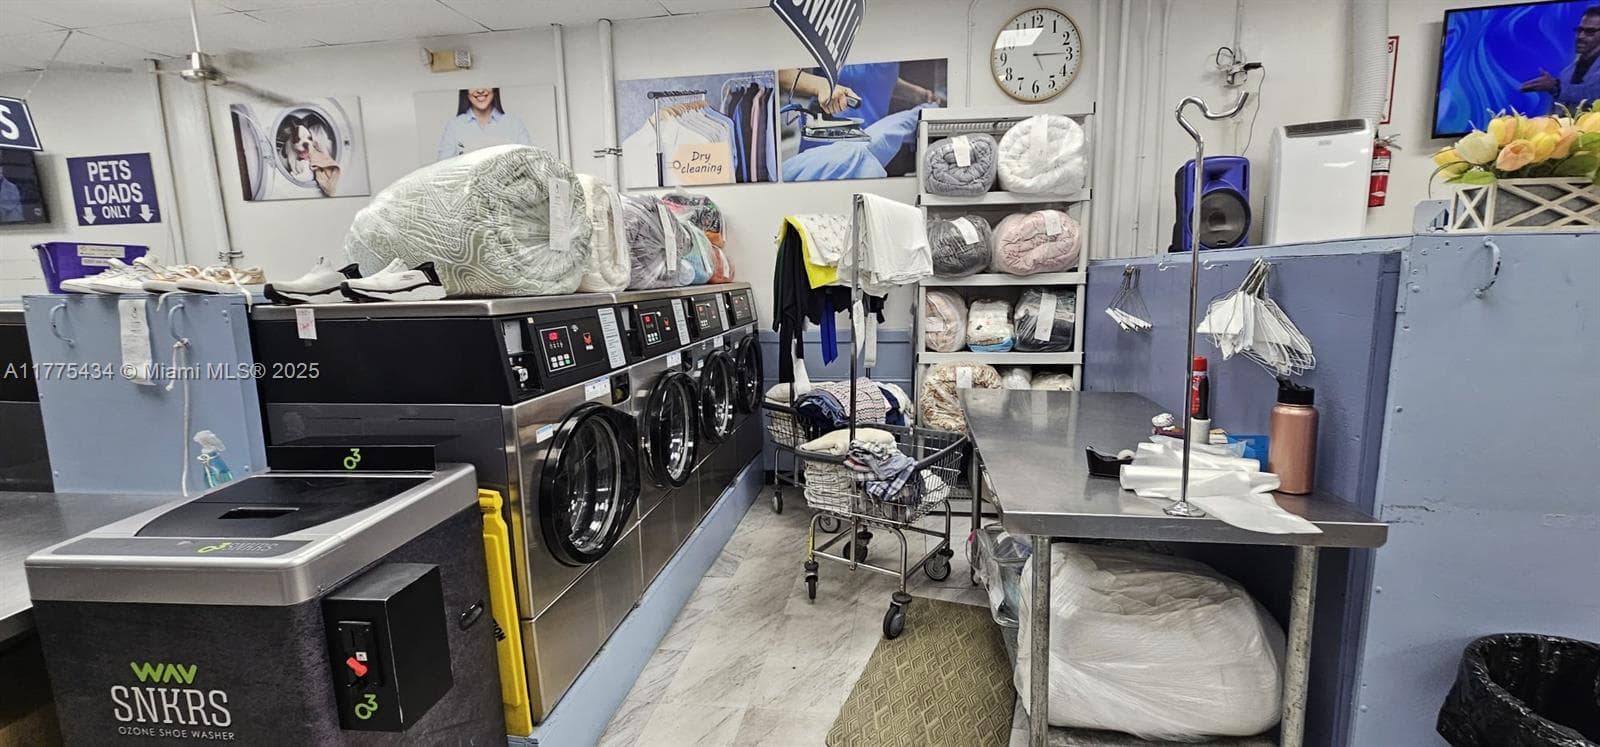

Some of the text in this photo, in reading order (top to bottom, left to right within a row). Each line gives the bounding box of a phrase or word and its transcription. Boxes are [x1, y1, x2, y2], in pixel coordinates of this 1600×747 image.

[1031, 14, 1044, 28] 12
[1062, 31, 1070, 46] 2
[1000, 52, 1008, 66] 9
[1065, 46, 1073, 61] 3
[1005, 67, 1013, 81] 8
[1059, 63, 1067, 77] 4
[1017, 77, 1025, 91] 7
[1031, 79, 1040, 94] 6
[1048, 75, 1056, 89] 5
[691, 151, 711, 163] Dry
[86, 159, 132, 182] PETS
[680, 163, 722, 175] cleaning
[83, 182, 144, 205] LOADS
[101, 205, 131, 219] ONLY
[130, 661, 197, 684] WAV
[110, 685, 231, 727] SNKRS
[118, 726, 235, 741] OZONE SHOE WASHER
